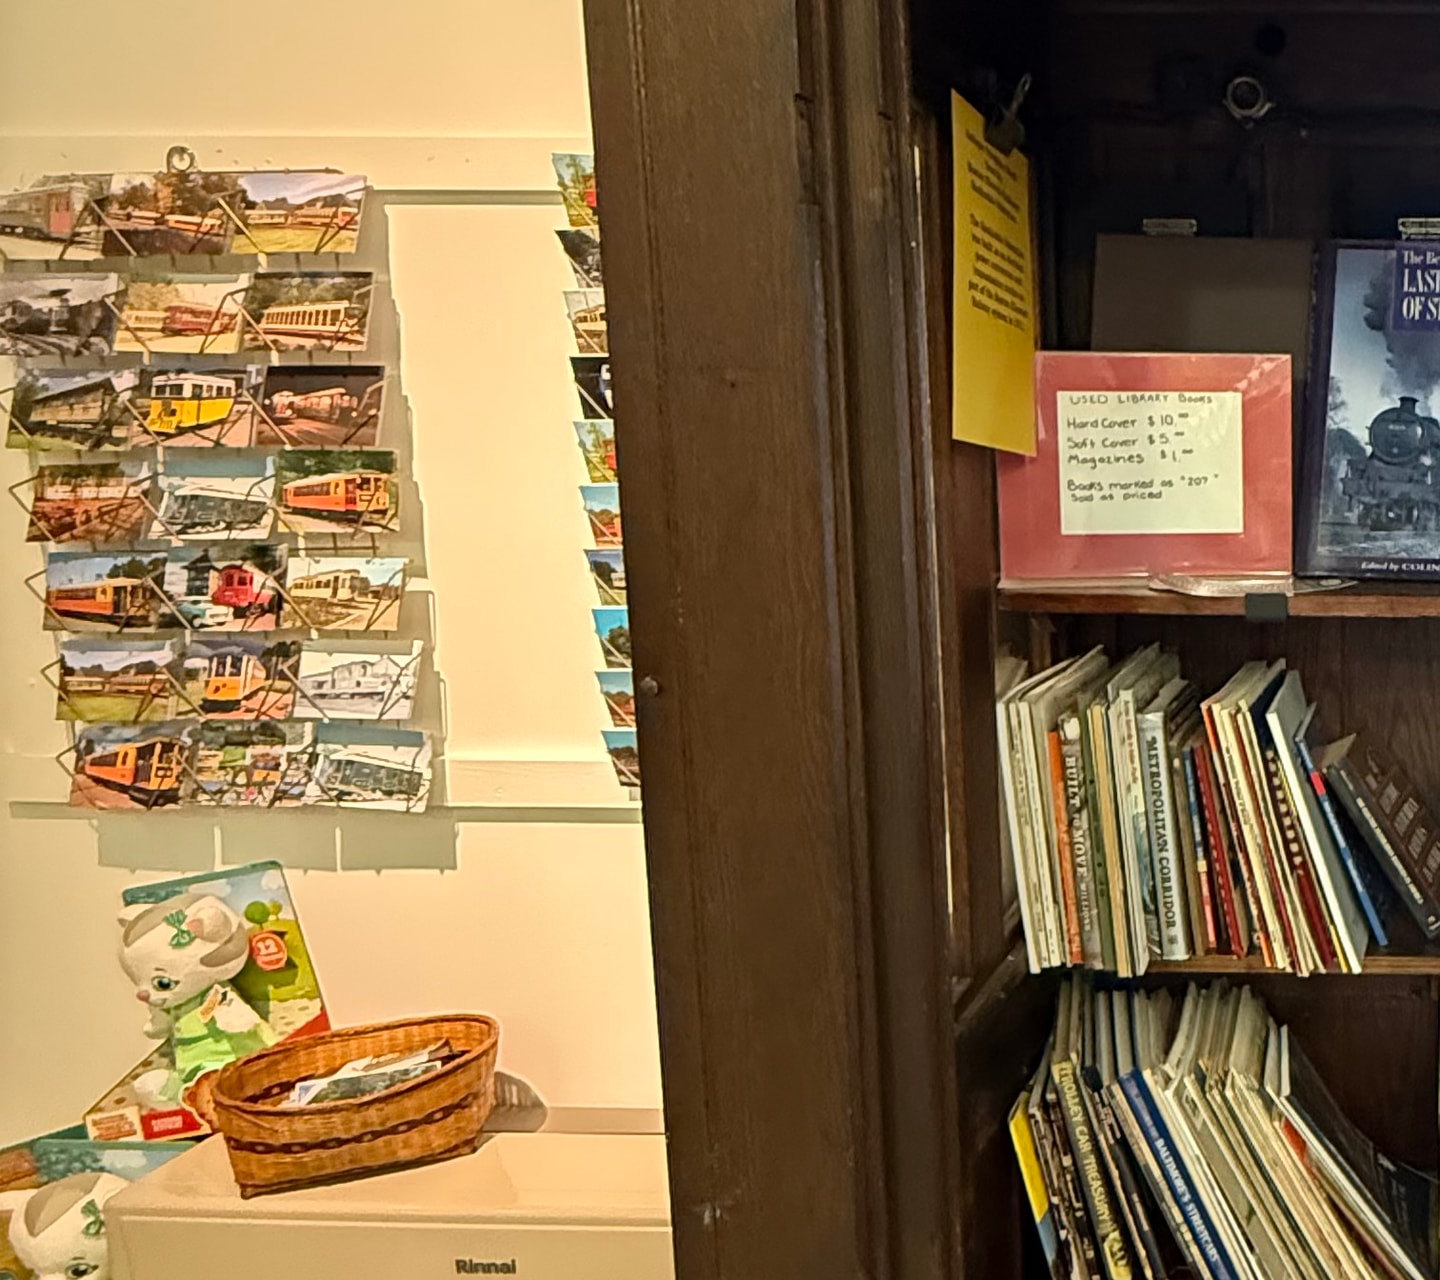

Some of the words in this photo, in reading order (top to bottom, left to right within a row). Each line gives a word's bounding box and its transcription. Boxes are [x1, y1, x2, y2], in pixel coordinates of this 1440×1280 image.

[1402, 250, 1424, 264] The
[1402, 296, 1423, 321] OF
[1069, 393, 1109, 405] USED
[1117, 393, 1169, 404] LIBRARY
[1067, 416, 1099, 429] Hard
[1102, 417, 1138, 429] Cover
[1067, 437, 1096, 450] Soft
[1101, 437, 1139, 448] Cover
[1067, 454, 1145, 470] Magazines
[1108, 479, 1154, 491] marked
[1161, 479, 1174, 488] as
[1100, 493, 1115, 501] as
[1402, 563, 1440, 573] COLIN
[1065, 757, 1082, 809] BUILT
[1146, 737, 1169, 852] METROPOLITAN
[1158, 858, 1177, 930] CORRIDOR
[1072, 829, 1088, 879] MOVE
[1059, 1060, 1083, 1122] TROLLEY
[1075, 1124, 1092, 1154] CAR
[1083, 1154, 1112, 1222] TREASURY
[1153, 1139, 1190, 1208] BALTIMORE'S
[1183, 1200, 1219, 1263] STREETCARS
[455, 1258, 516, 1275] Rinnai
